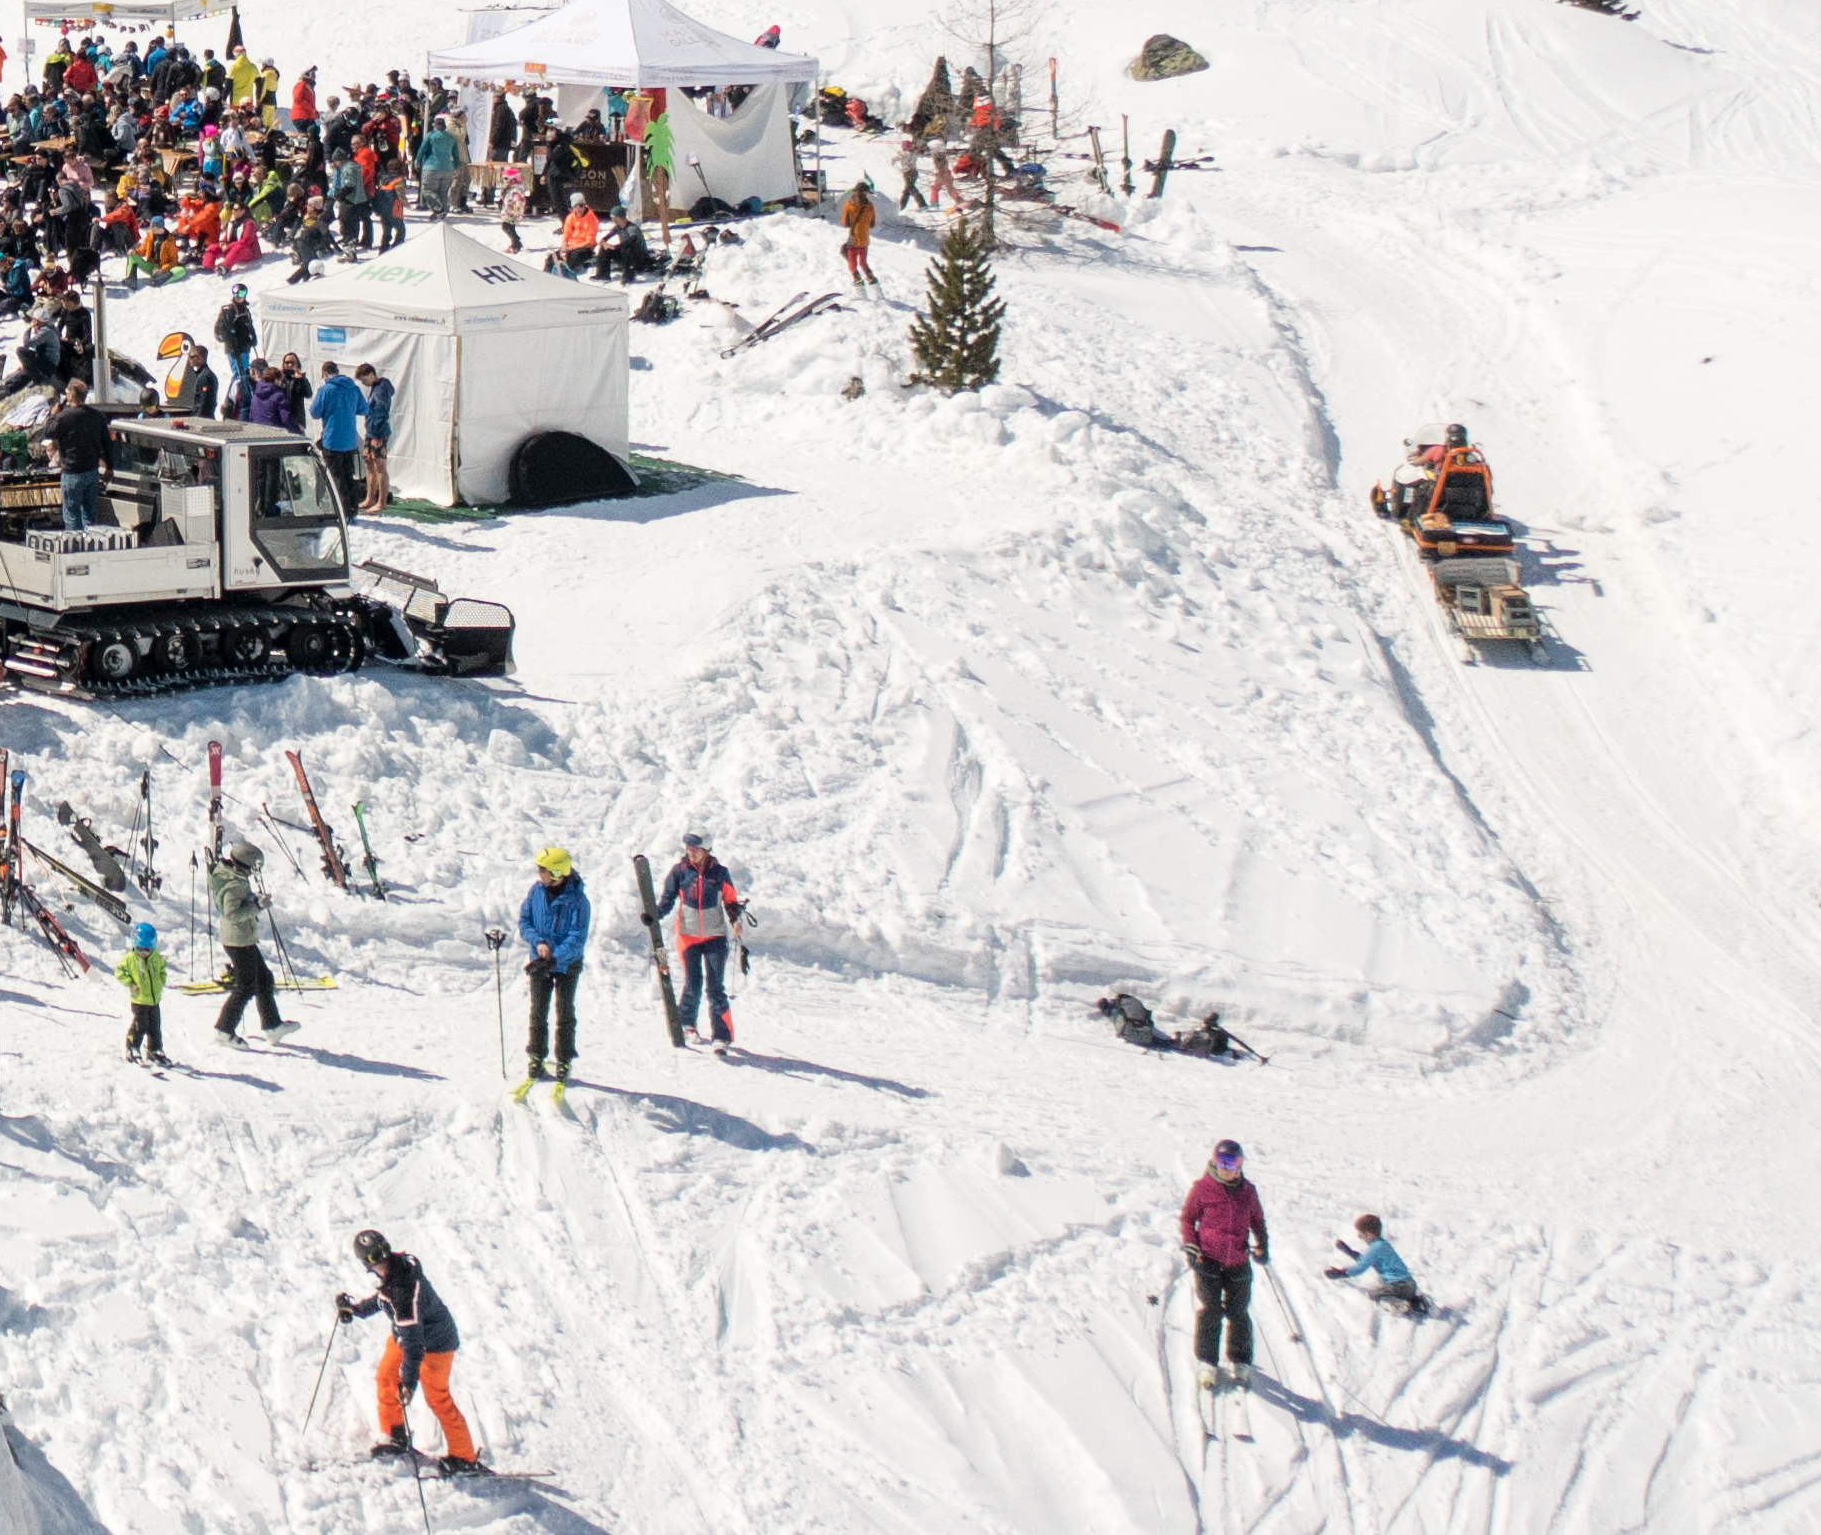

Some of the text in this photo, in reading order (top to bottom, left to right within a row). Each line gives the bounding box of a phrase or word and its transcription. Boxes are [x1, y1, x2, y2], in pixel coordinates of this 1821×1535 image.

[537, 29, 603, 39] MAISON
[529, 36, 594, 46] GILLIARD
[472, 264, 526, 285] HI!
